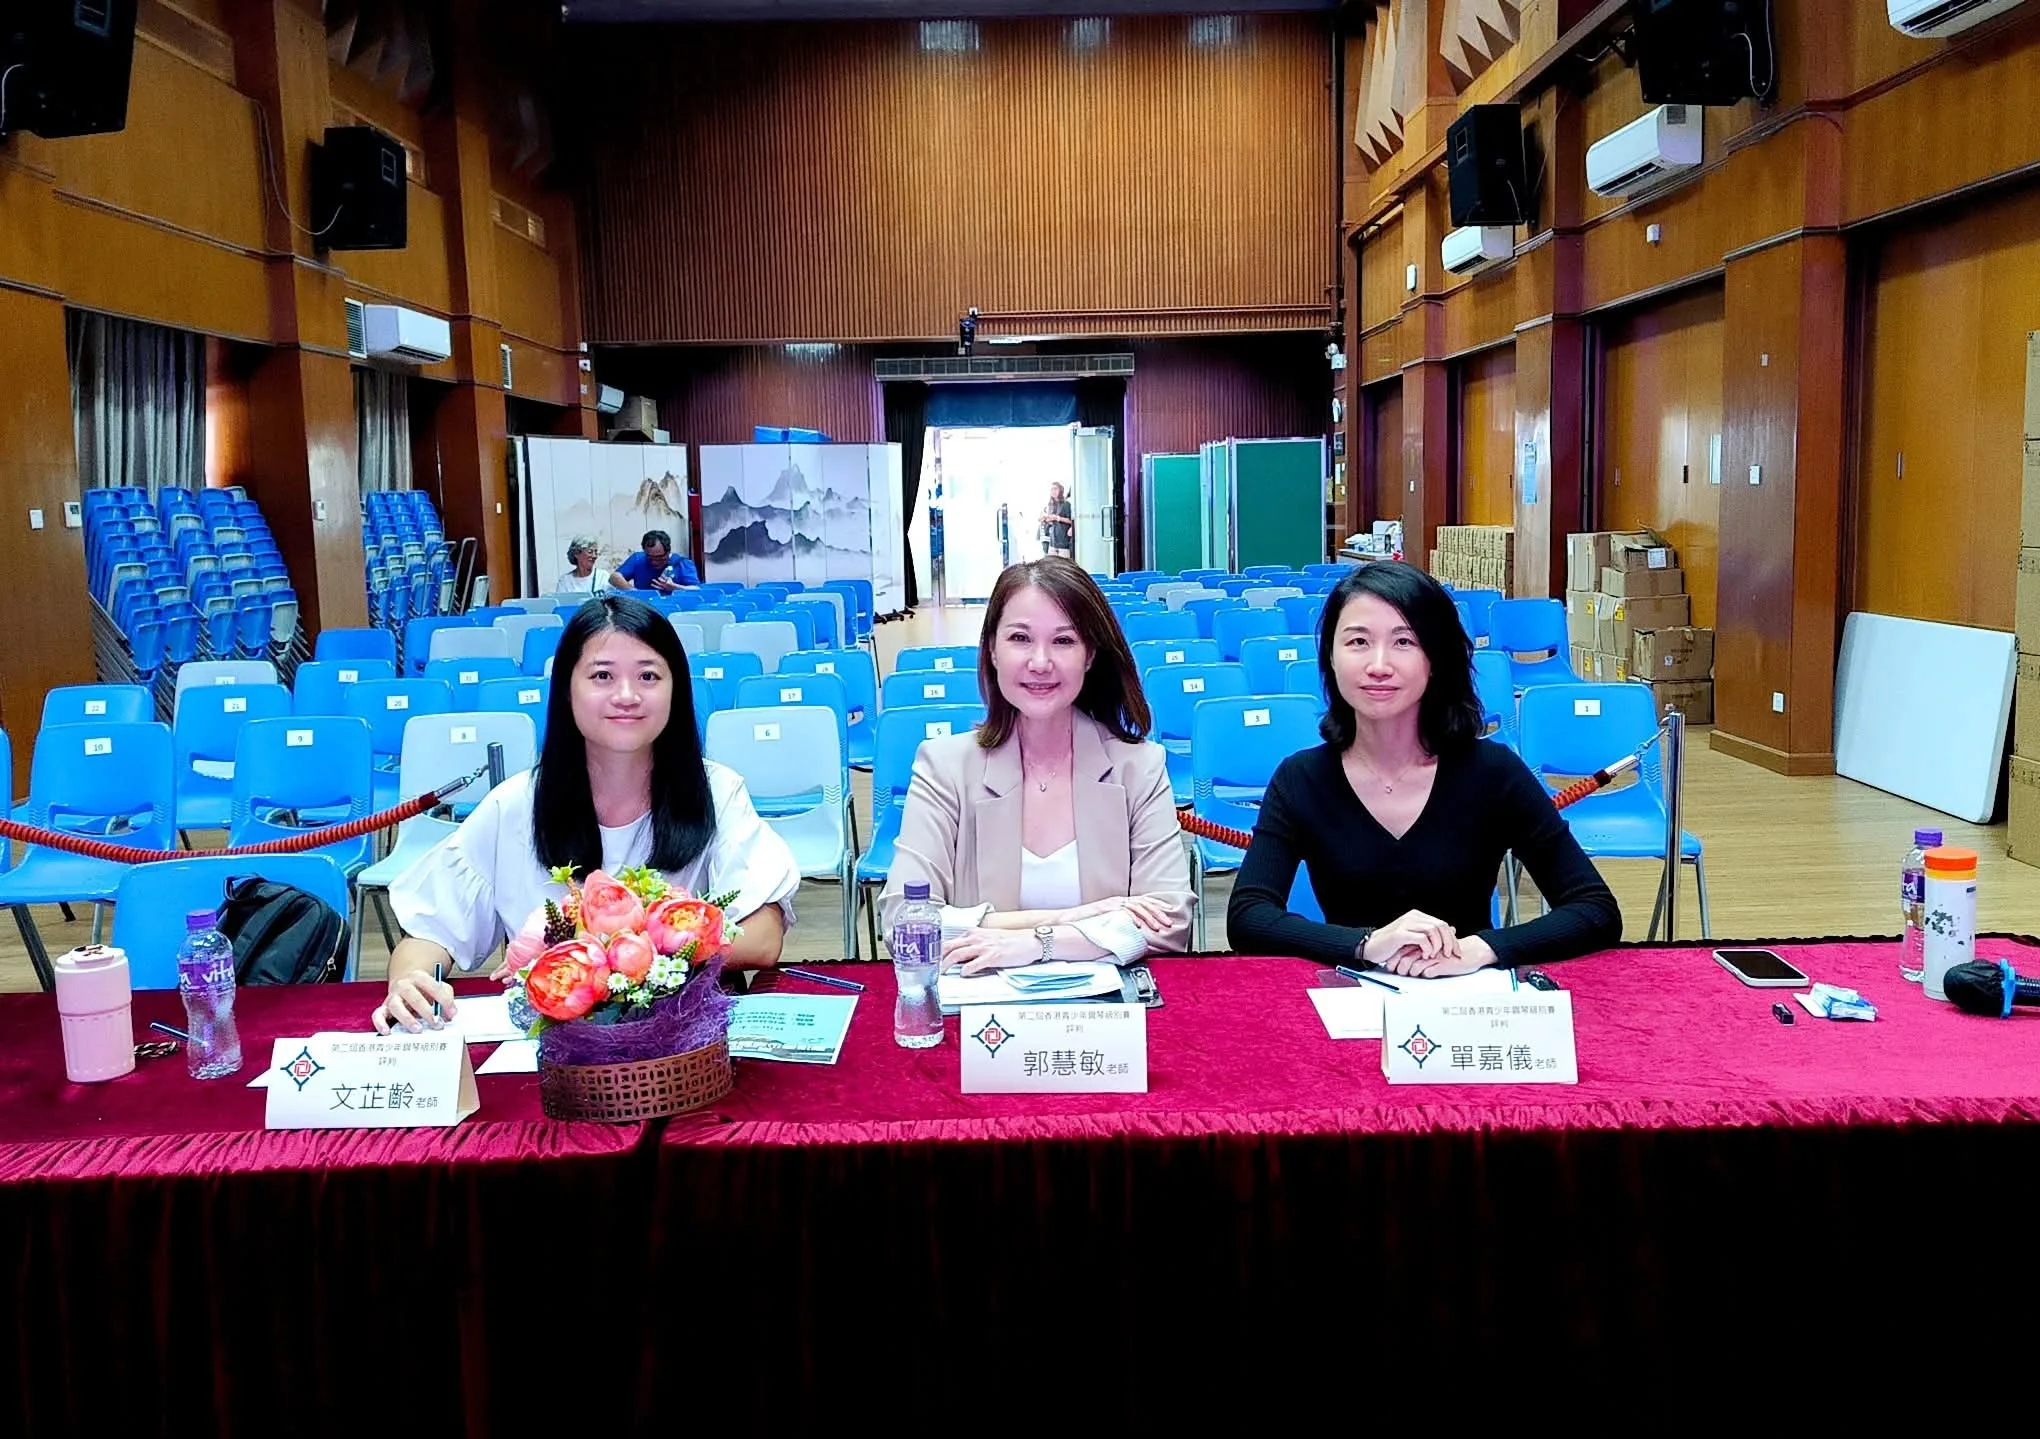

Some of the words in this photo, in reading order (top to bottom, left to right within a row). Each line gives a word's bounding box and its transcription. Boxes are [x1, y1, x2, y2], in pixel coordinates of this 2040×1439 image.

[1255, 714, 1261, 723] 3
[765, 729, 770, 737] 6
[936, 727, 942, 736] 5
[297, 735, 303, 743] 9
[93, 743, 103, 752] 10
